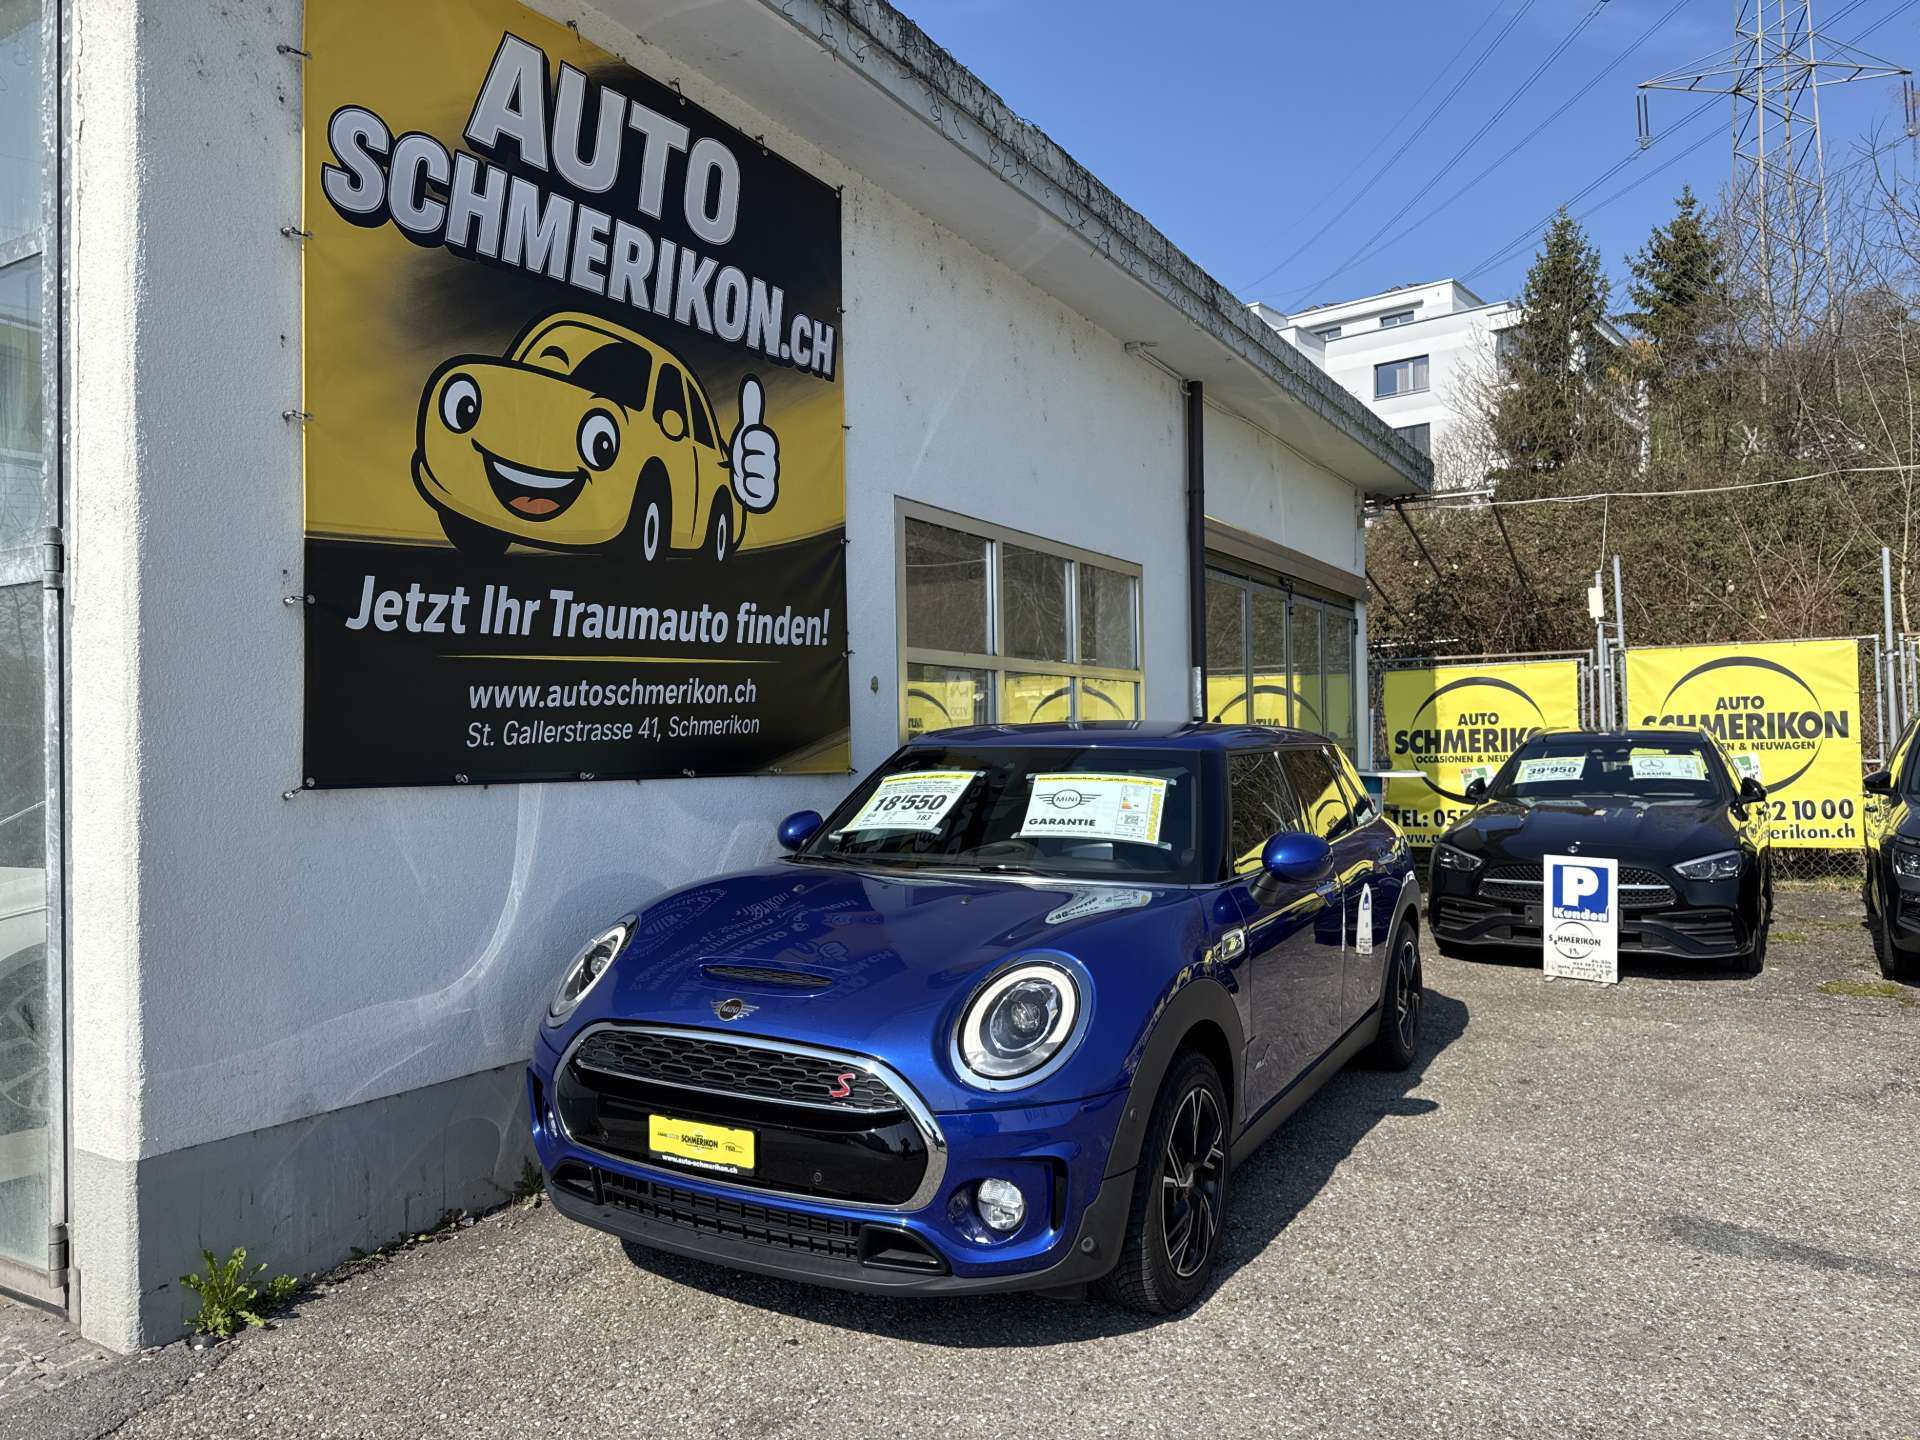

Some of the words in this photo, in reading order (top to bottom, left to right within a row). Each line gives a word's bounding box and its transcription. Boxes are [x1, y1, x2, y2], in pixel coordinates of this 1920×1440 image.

[466, 32, 740, 246] AUTO
[324, 107, 836, 377] SCHMERIKON.CH
[345, 575, 470, 635] Jetzt
[480, 585, 540, 638] Ihr
[550, 589, 730, 645] Traumauto
[736, 603, 830, 647] finden!
[469, 678, 757, 710] www.autoschmerikon.ch
[1715, 695, 1765, 711] AUTO
[1458, 712, 1500, 726] AUTO
[466, 722, 495, 749] St.
[503, 718, 633, 747] Gallerstrasse
[638, 717, 661, 743] 41,
[668, 715, 760, 738] Schmerikon
[1738, 742, 1747, 751] &
[1751, 741, 1816, 751] NEUWAGEN
[1416, 755, 1474, 764] OCCASIONEN
[1477, 755, 1484, 763] &
[873, 794, 948, 812] 18'550
[1794, 800, 1817, 821] 10
[1821, 799, 1855, 820] 00
[1028, 818, 1097, 827] GARANTIE
[1390, 809, 1429, 828] TEL:
[1769, 823, 1856, 841] erikon.ch
[1562, 866, 1600, 907] P
[830, 1073, 856, 1098] S
[681, 1134, 719, 1149] SCHMERIKON
